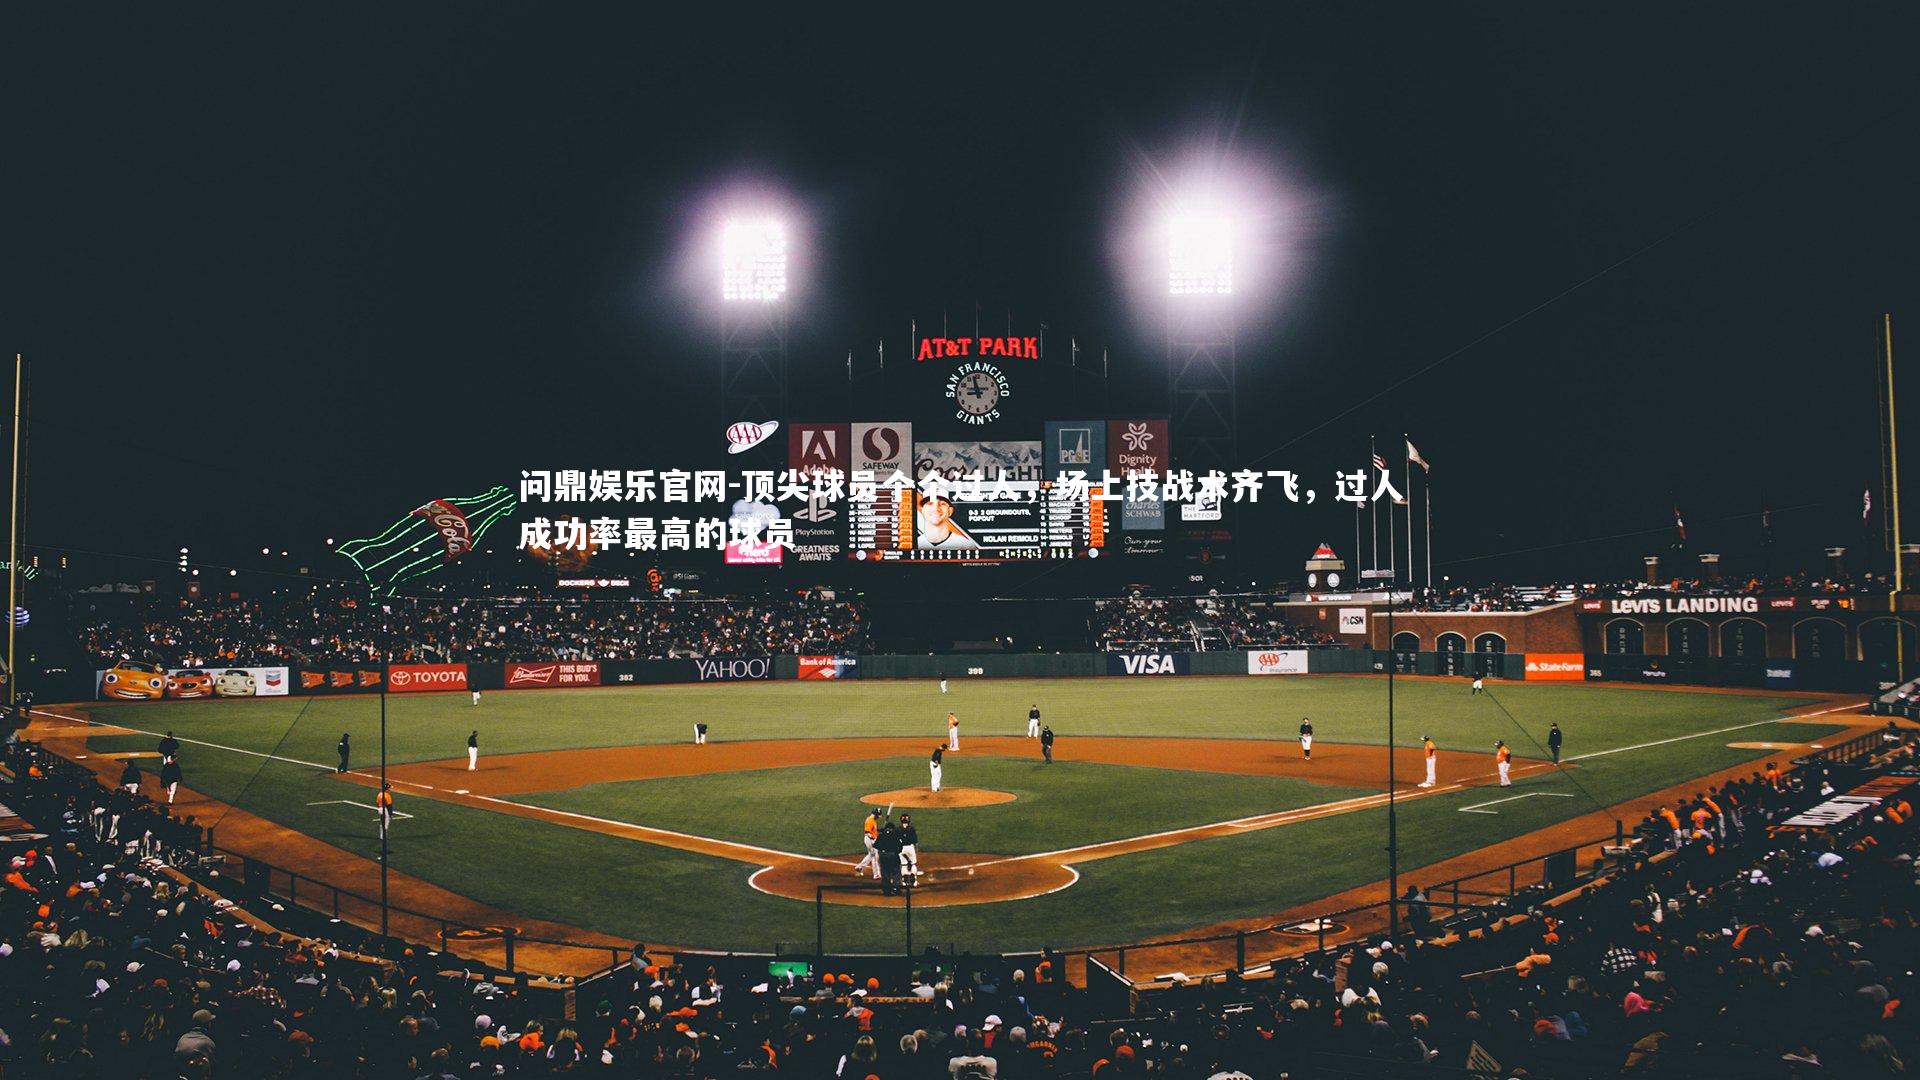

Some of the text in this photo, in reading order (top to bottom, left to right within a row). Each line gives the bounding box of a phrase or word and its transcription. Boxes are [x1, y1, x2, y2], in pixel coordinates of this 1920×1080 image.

[917, 336, 1039, 361] AT&T PARK
[945, 361, 1010, 398] SAN FRANCISCO
[955, 408, 1001, 425] GIANTS
[1061, 448, 1089, 463] PG&E
[1119, 454, 1157, 466] Dignity
[862, 462, 900, 470] SAFEWAY
[1125, 510, 1162, 518] SCHWAB
[795, 528, 835, 538] PlayStation
[983, 535, 1039, 543] NOLAN REIMOLD
[791, 545, 840, 553] GREATNESS
[798, 553, 832, 561] AWAITS
[558, 579, 596, 587] DOCKERS
[1665, 597, 1759, 613] LANDING
[1349, 616, 1364, 625] CSN
[799, 657, 857, 667] Bank of America
[1119, 655, 1176, 674] VISA
[559, 663, 598, 673] THIS BUD'S
[695, 658, 770, 681] YAHOO!
[413, 671, 467, 683] TOYOTA
[559, 673, 590, 683] FOR YOU.
